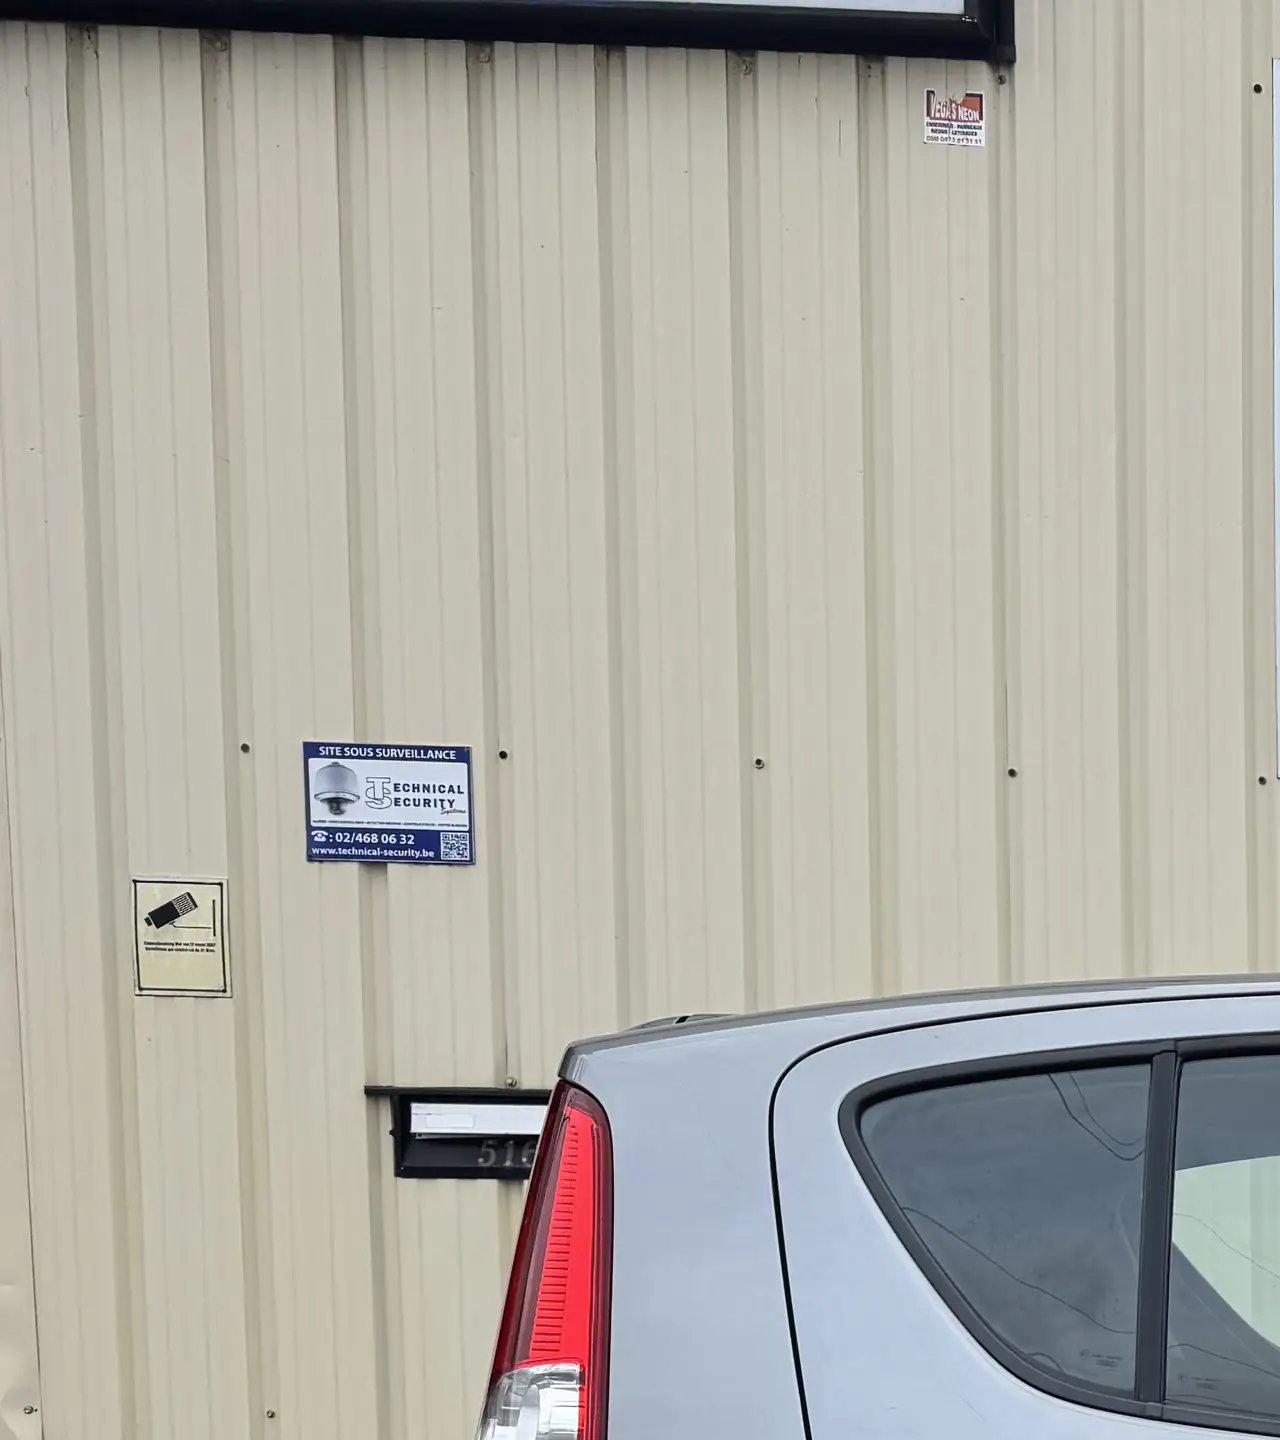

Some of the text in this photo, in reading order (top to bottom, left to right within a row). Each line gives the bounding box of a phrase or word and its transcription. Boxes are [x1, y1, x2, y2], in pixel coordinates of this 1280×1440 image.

[319, 746, 456, 760] SITE SOUS SURVEILLANCE
[335, 833, 379, 844] 02/468
[381, 834, 397, 844] 06
[399, 834, 415, 845] 32
[311, 847, 435, 858] www.technical-security.be
